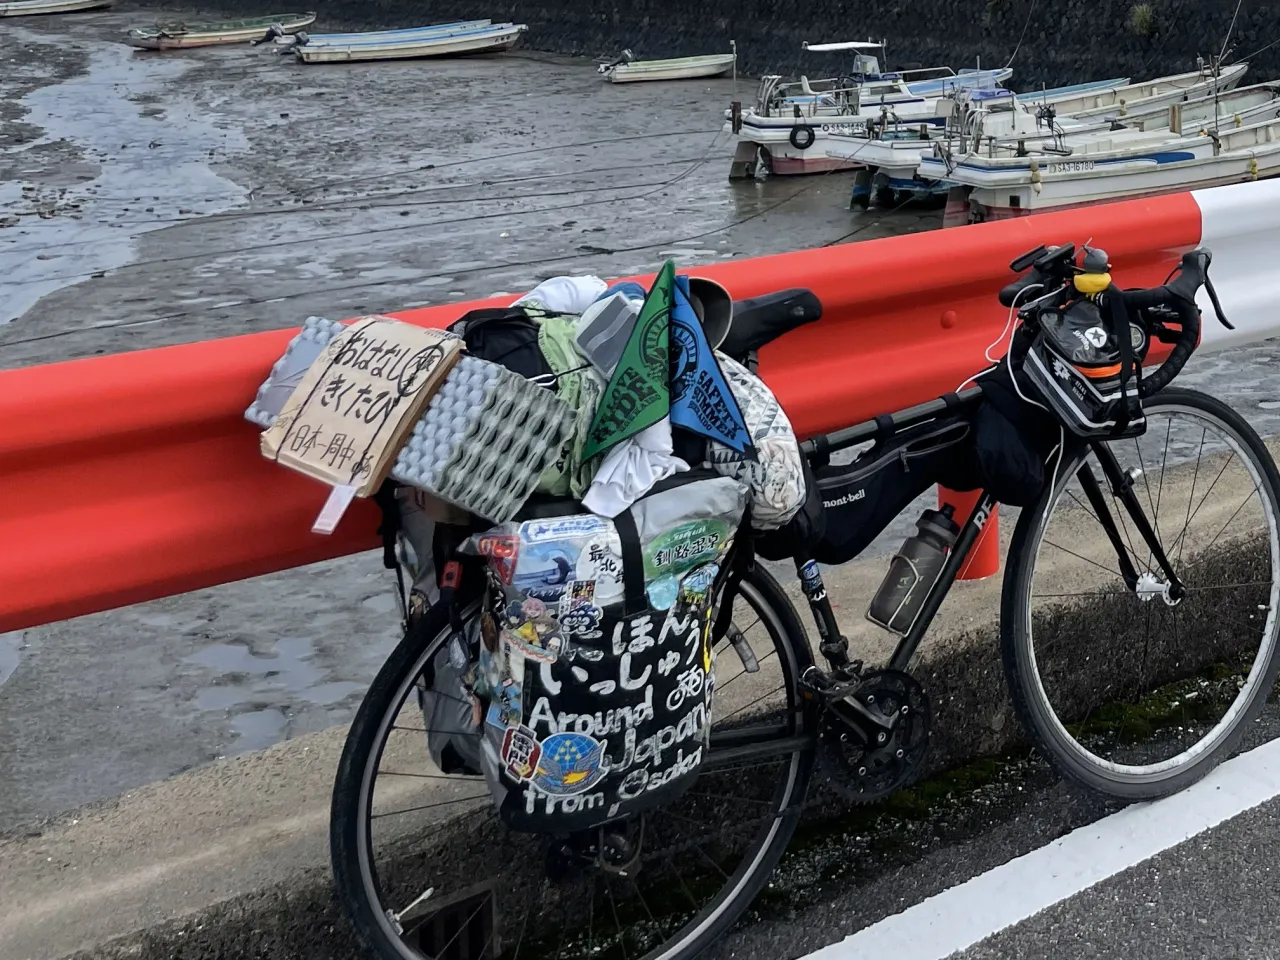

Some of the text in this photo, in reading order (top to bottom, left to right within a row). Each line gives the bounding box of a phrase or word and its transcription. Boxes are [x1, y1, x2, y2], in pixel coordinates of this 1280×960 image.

[333, 331, 410, 381] おはなし
[320, 373, 399, 424] きくたび
[592, 377, 658, 444] RIDE
[692, 385, 737, 440] SUMMER
[697, 370, 744, 432] SAFETY
[290, 423, 356, 470] 日本一周中
[653, 531, 721, 567] 釧路湿原
[540, 619, 700, 695] いっしゅう
[528, 684, 654, 737] Around
[603, 701, 705, 773] Japan
[522, 745, 703, 815] from Osaka
